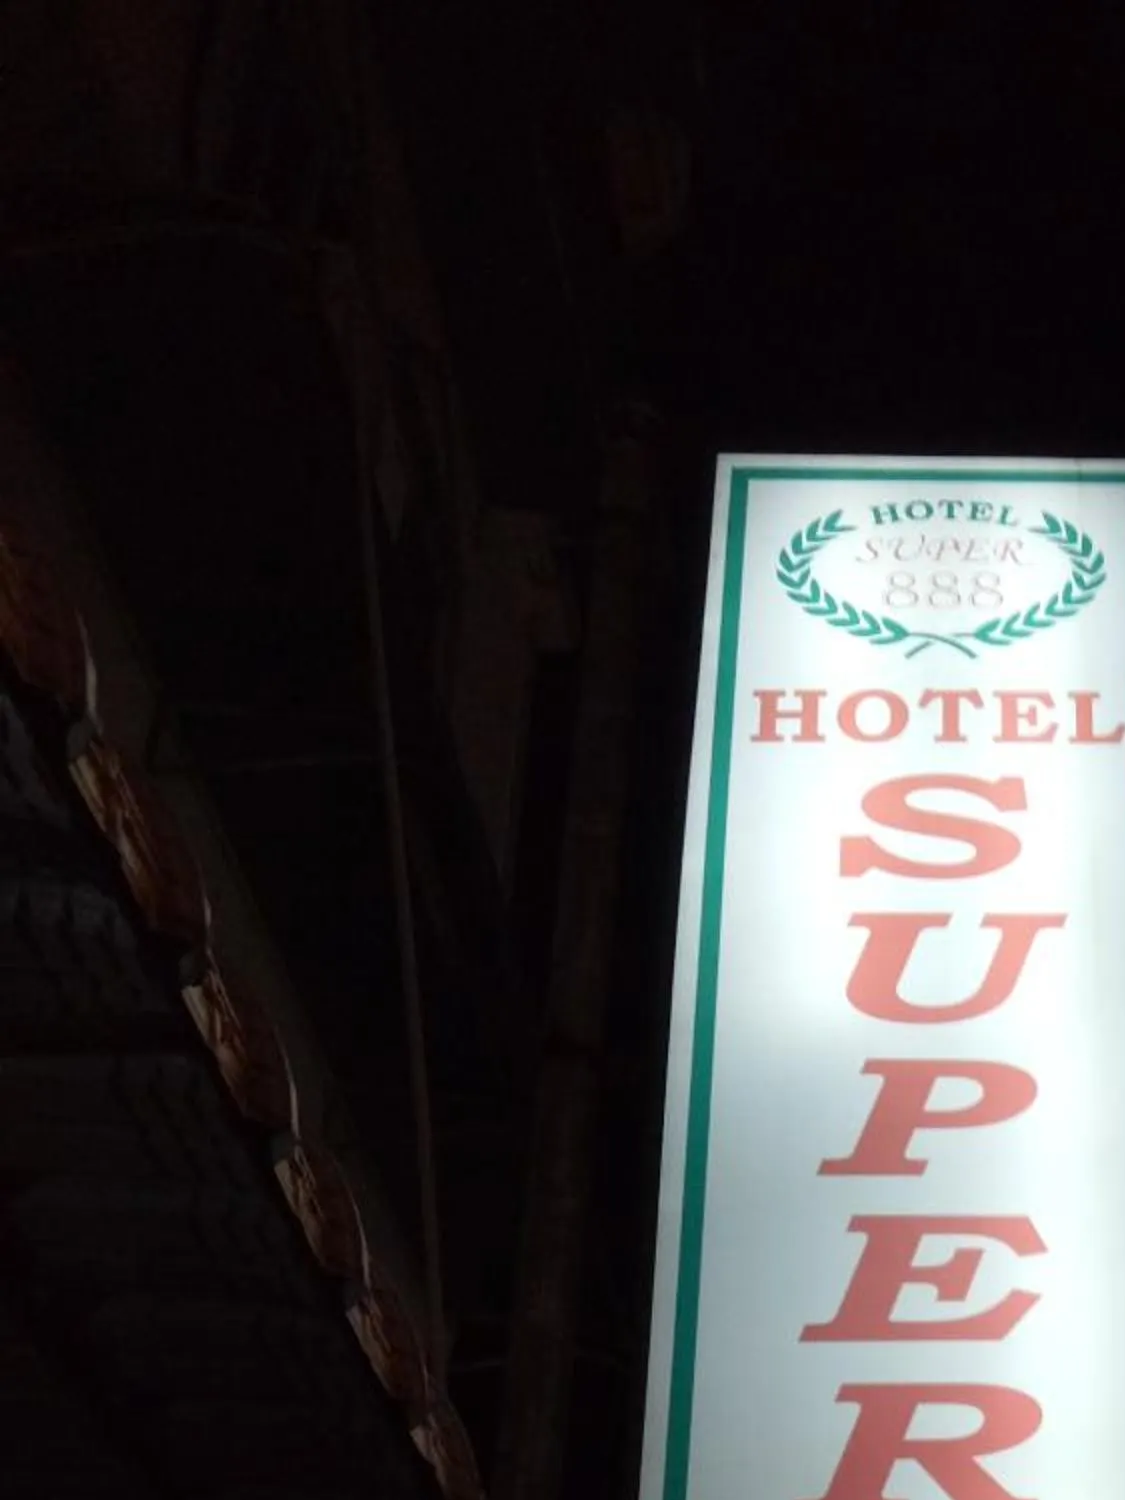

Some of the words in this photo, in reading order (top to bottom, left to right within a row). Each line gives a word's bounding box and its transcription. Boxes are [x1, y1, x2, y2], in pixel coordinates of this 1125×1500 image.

[869, 499, 1020, 526] HOTEL
[855, 533, 1027, 566] SUPER
[882, 571, 1004, 608] 888
